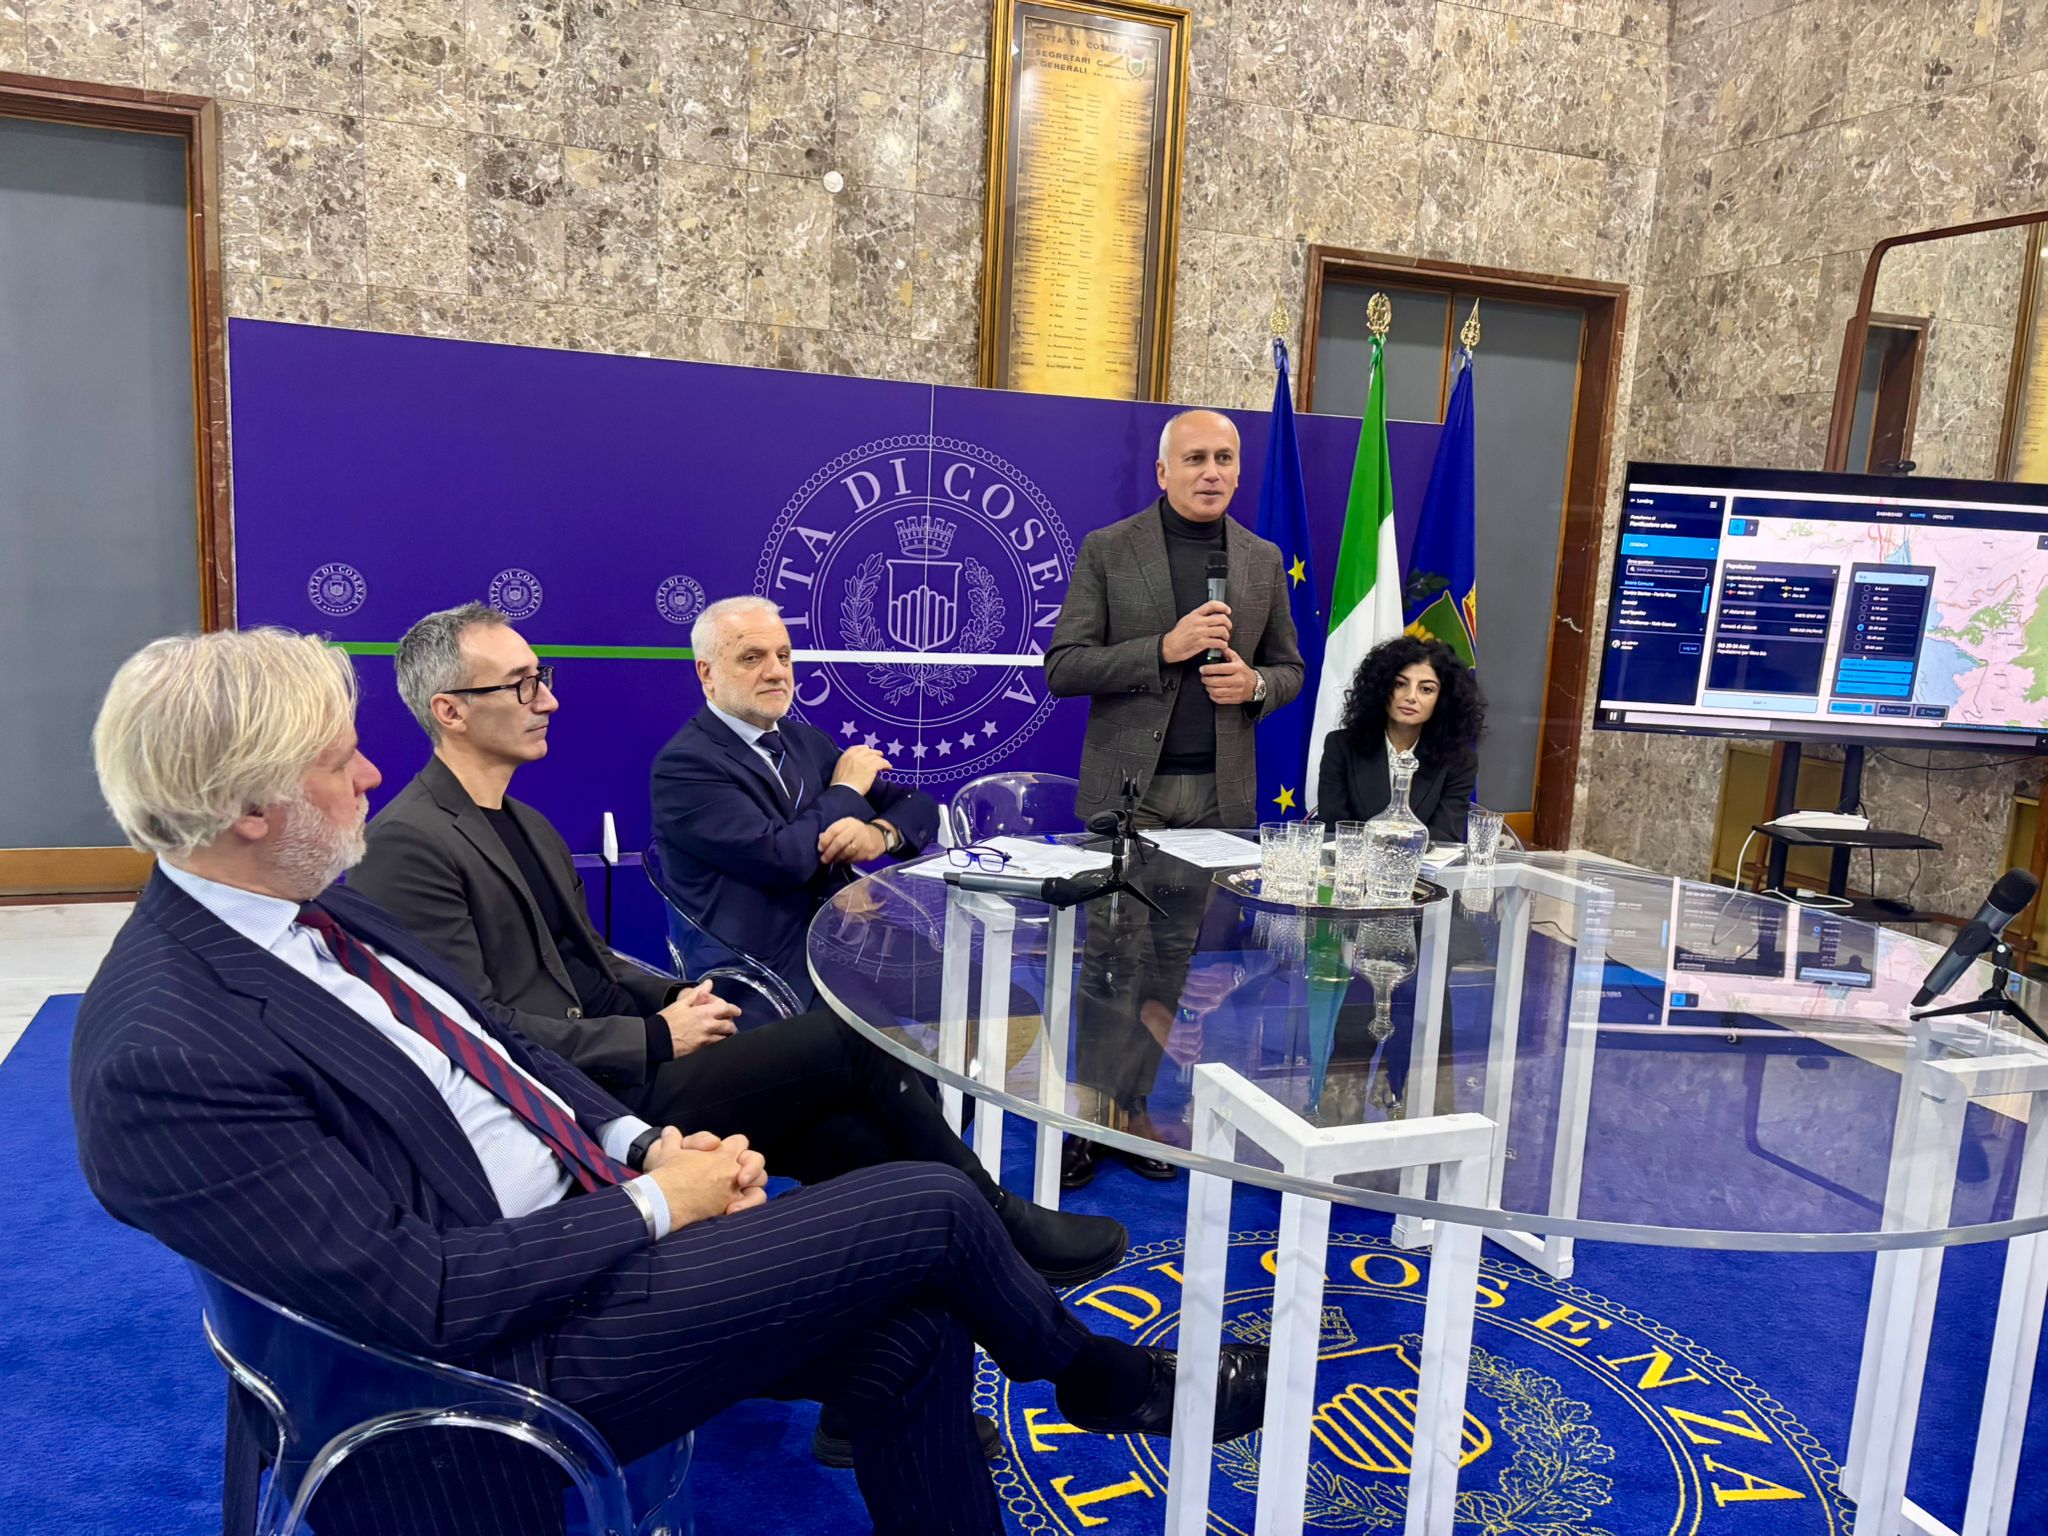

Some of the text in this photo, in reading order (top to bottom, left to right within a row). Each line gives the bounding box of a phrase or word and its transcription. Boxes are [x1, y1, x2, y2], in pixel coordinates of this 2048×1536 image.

[1086, 42, 1130, 56] COSENZA
[1036, 49, 1091, 65] SEGRETARI
[1040, 61, 1087, 74] GENERALI
[841, 458, 912, 513] DI
[1726, 562, 1757, 571] Popolazione
[339, 566, 364, 605] COSENZA
